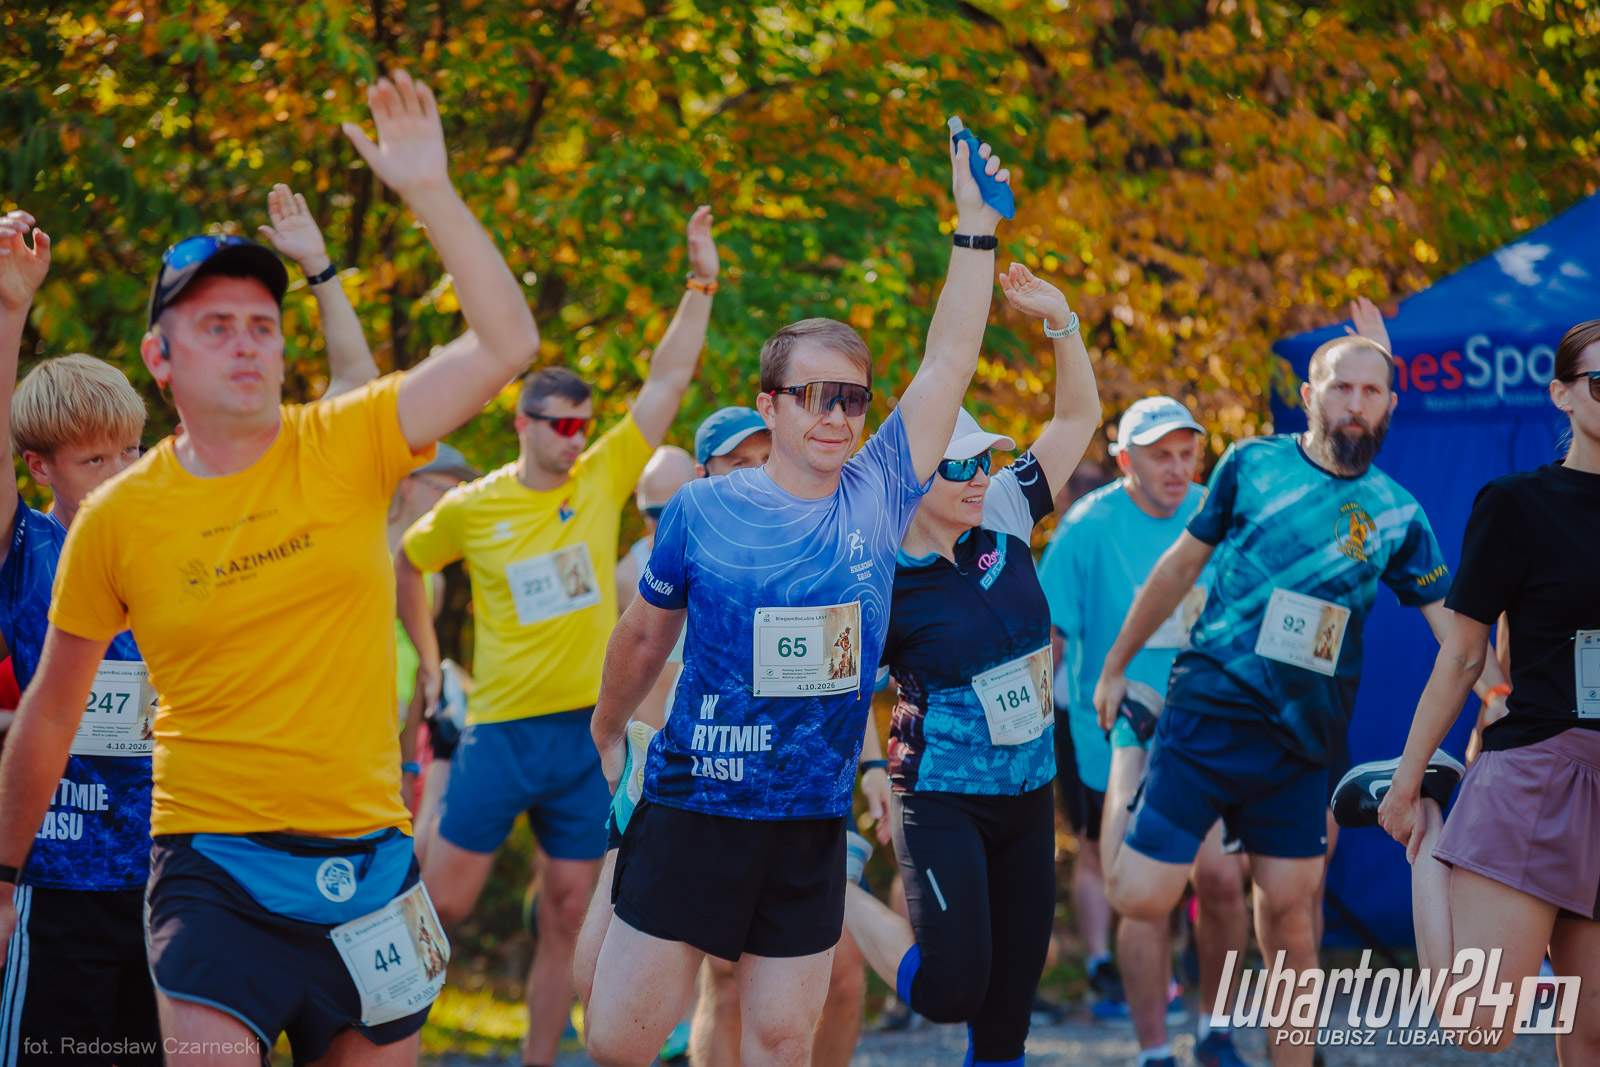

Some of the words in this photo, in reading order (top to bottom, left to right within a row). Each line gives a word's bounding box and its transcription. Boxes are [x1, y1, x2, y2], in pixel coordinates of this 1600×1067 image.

[214, 533, 314, 577] KAZIMIERZ
[1282, 613, 1307, 635] 92
[777, 636, 808, 658] 65
[796, 682, 836, 692] 4.10.2026
[995, 685, 1032, 713] 184
[86, 690, 130, 714] 247
[699, 694, 720, 720] W
[106, 743, 148, 751] 4.10.2026
[690, 724, 773, 753] RYTMIE
[690, 755, 744, 782] LASU
[374, 942, 402, 972] 44
